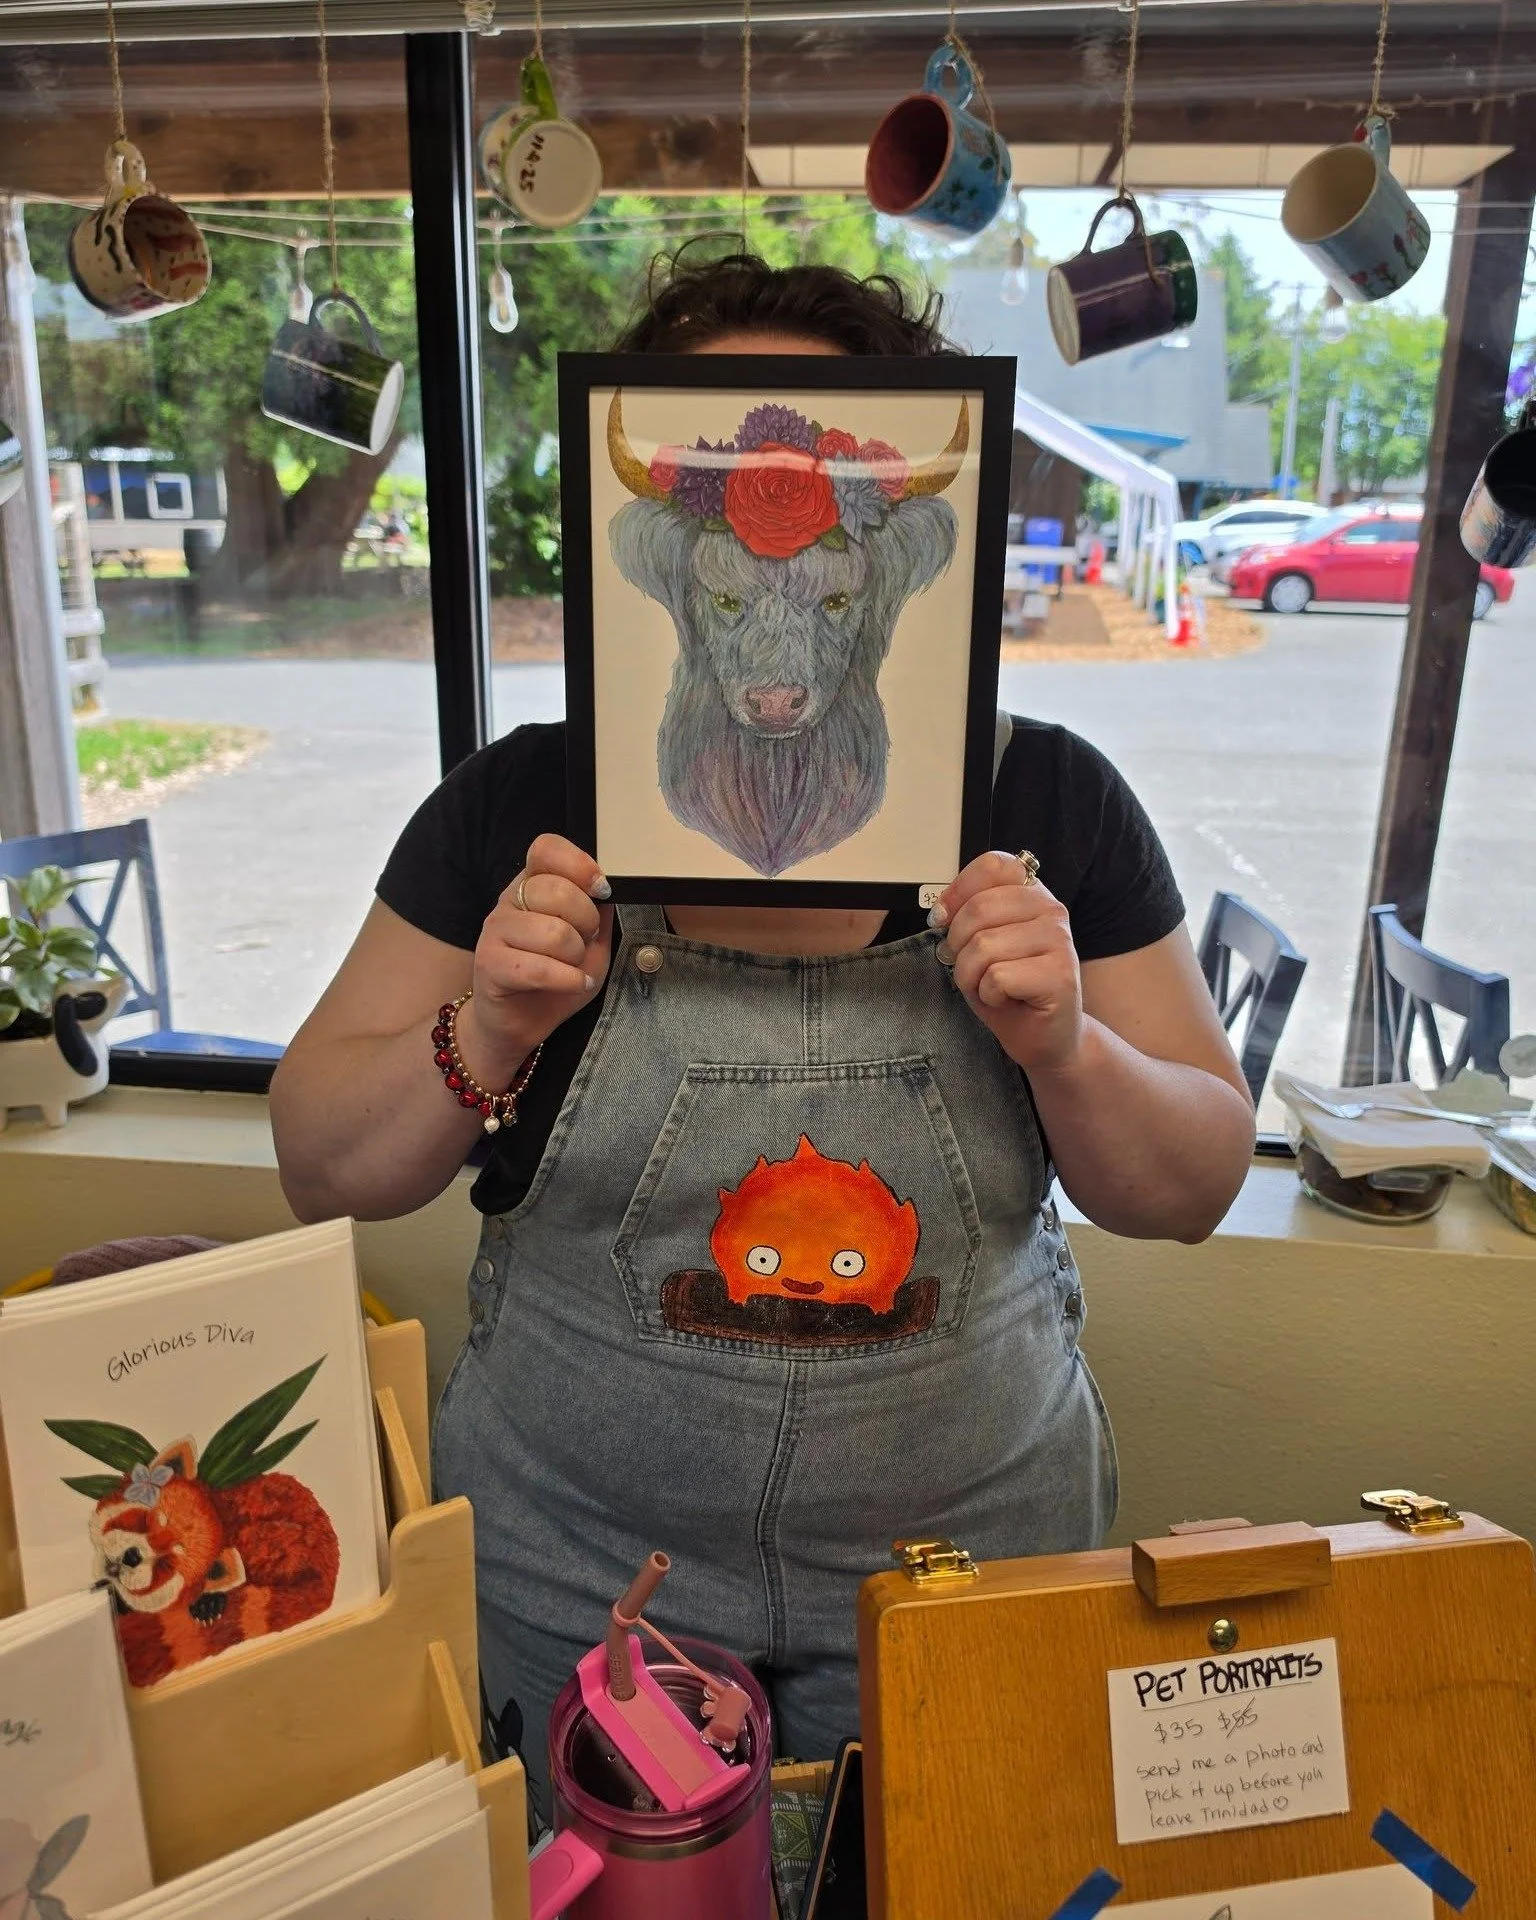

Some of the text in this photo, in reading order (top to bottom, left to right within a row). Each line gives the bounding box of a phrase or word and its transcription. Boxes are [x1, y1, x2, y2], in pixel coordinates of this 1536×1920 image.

[107, 1323, 255, 1381] Glorious Diva
[1133, 1652, 1323, 1708] PET PORTRAITS
[1154, 1718, 1203, 1744] $35
[1136, 1735, 1324, 1781] send me a photo and
[1145, 1767, 1324, 1811] pick it up before you
[1150, 1799, 1269, 1829] leave Trinidad
